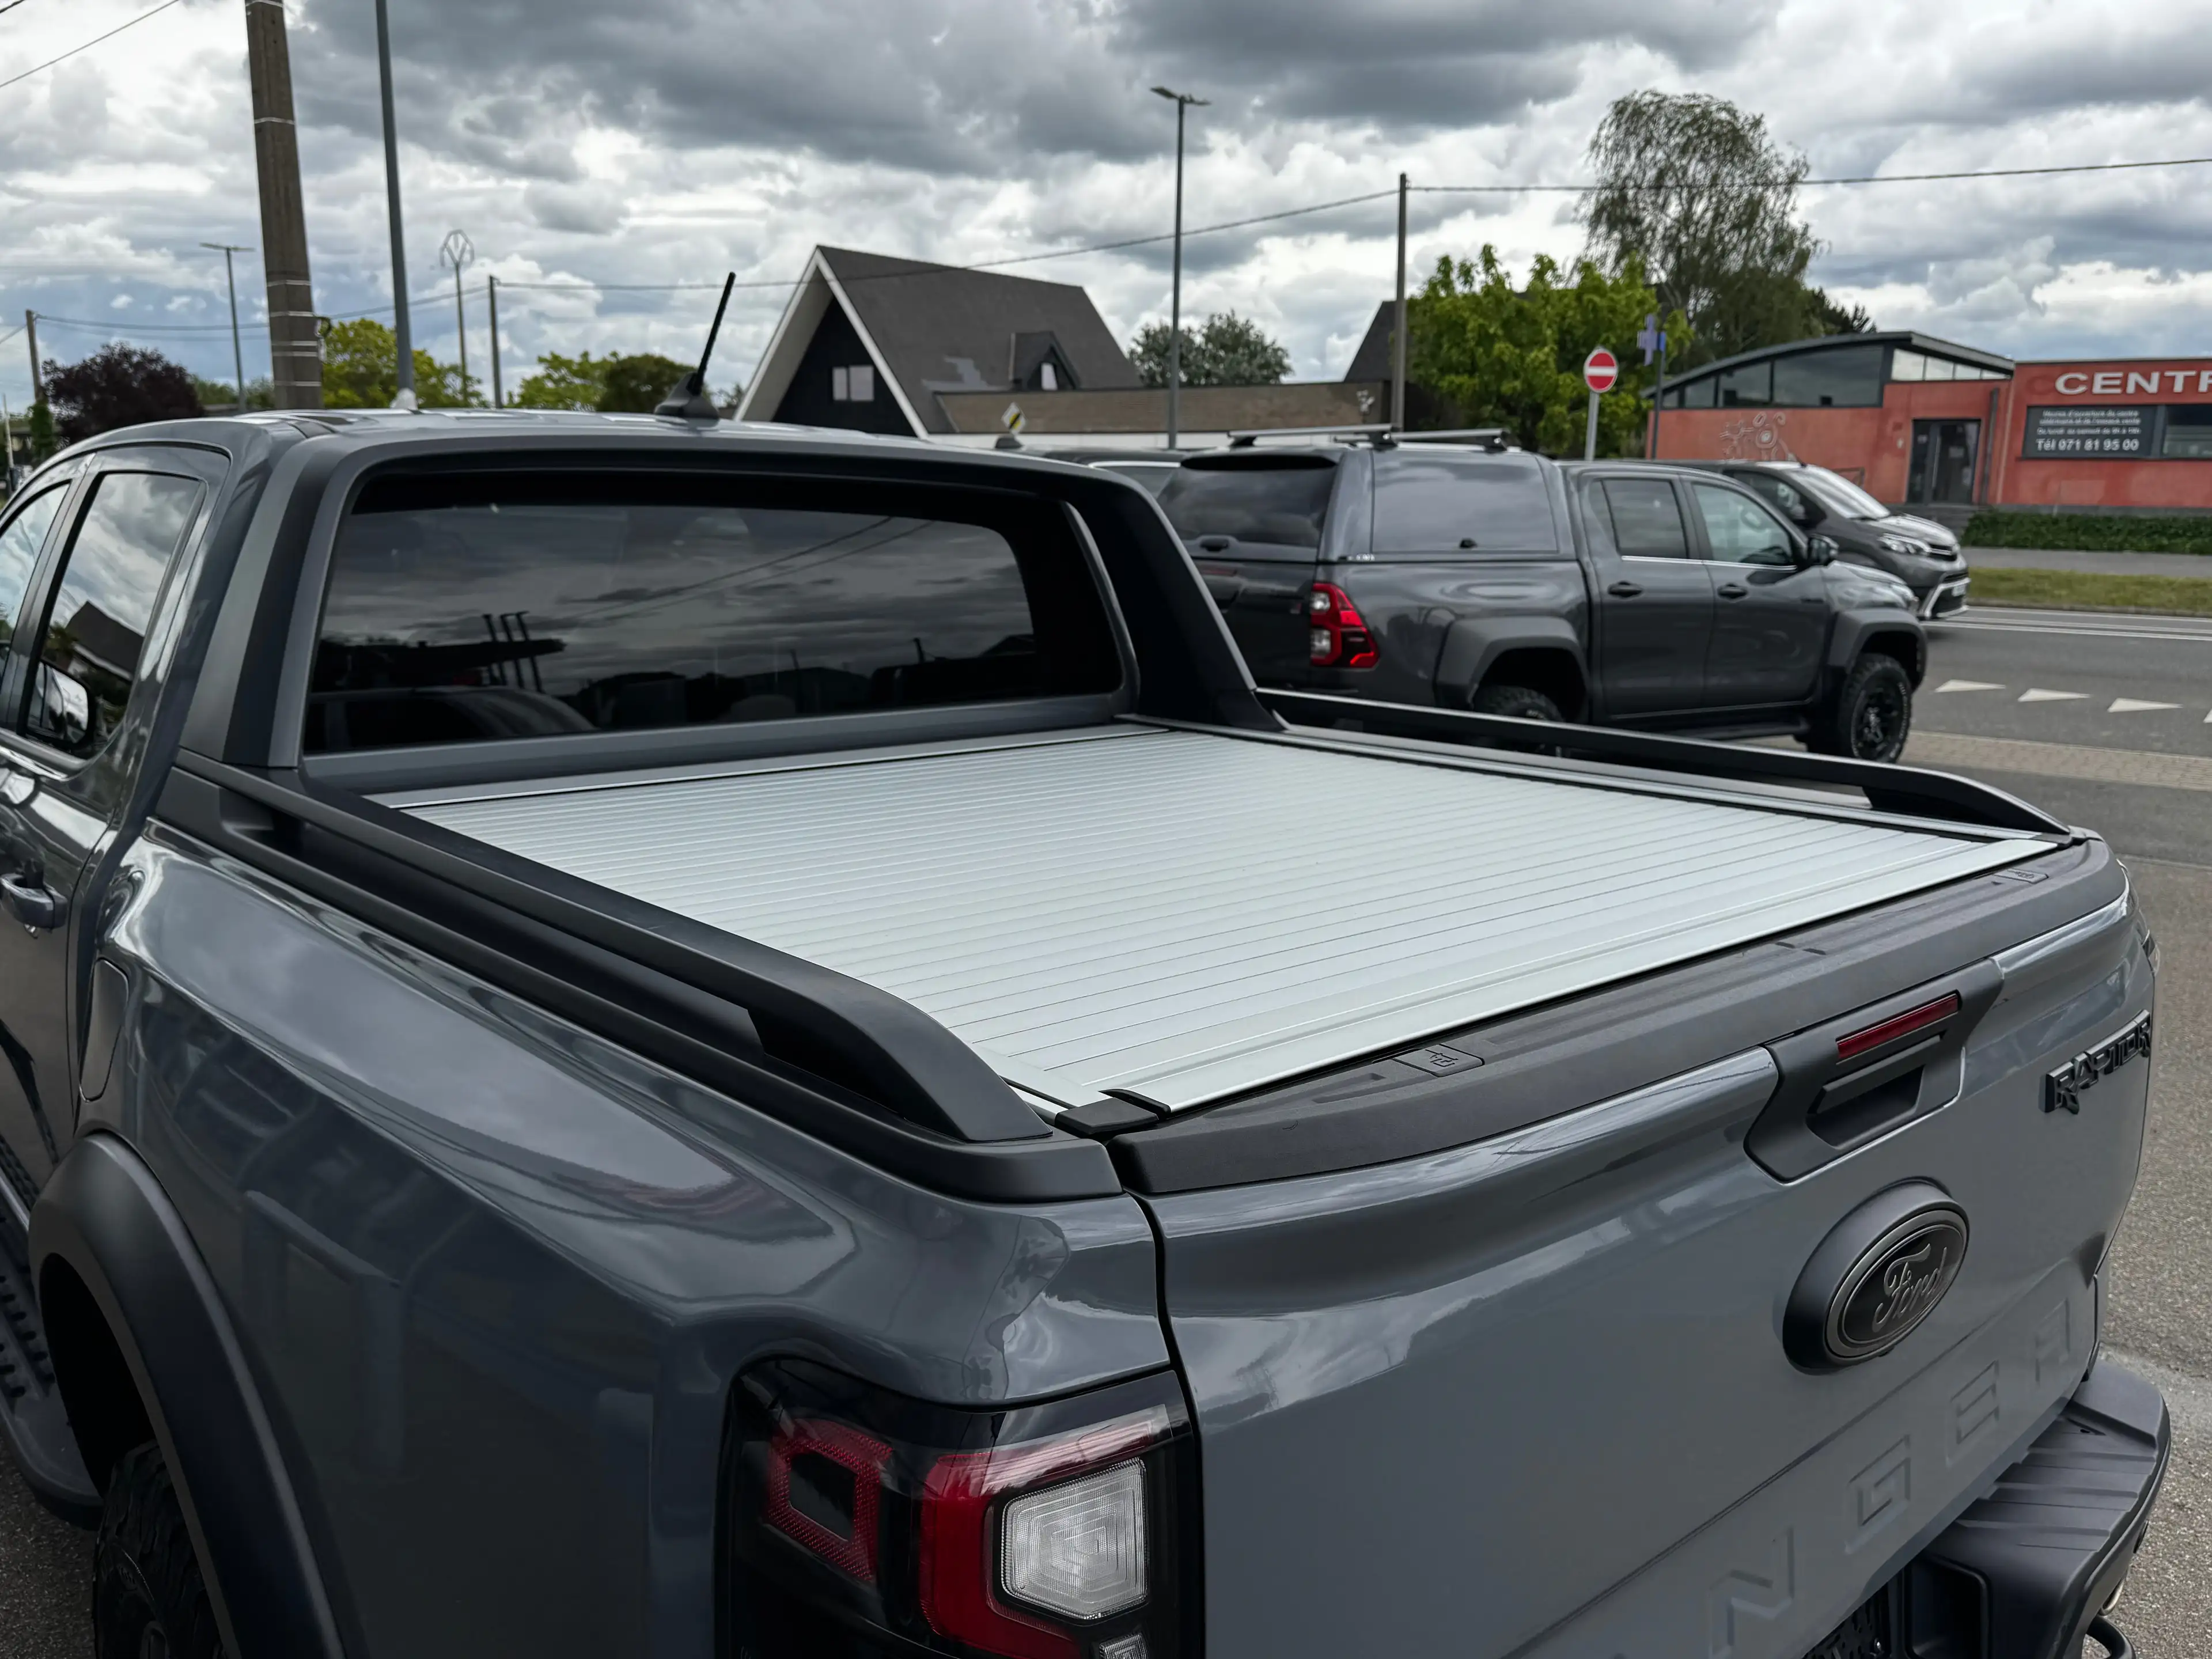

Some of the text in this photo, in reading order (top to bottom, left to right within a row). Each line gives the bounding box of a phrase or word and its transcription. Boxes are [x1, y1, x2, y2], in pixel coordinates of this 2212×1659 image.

[2036, 438, 2056, 451] Tél
[2058, 438, 2081, 451] 071
[2122, 438, 2139, 451] 00
[1872, 1243, 1948, 1333] Ford
[1609, 1296, 2073, 1659] NGER
